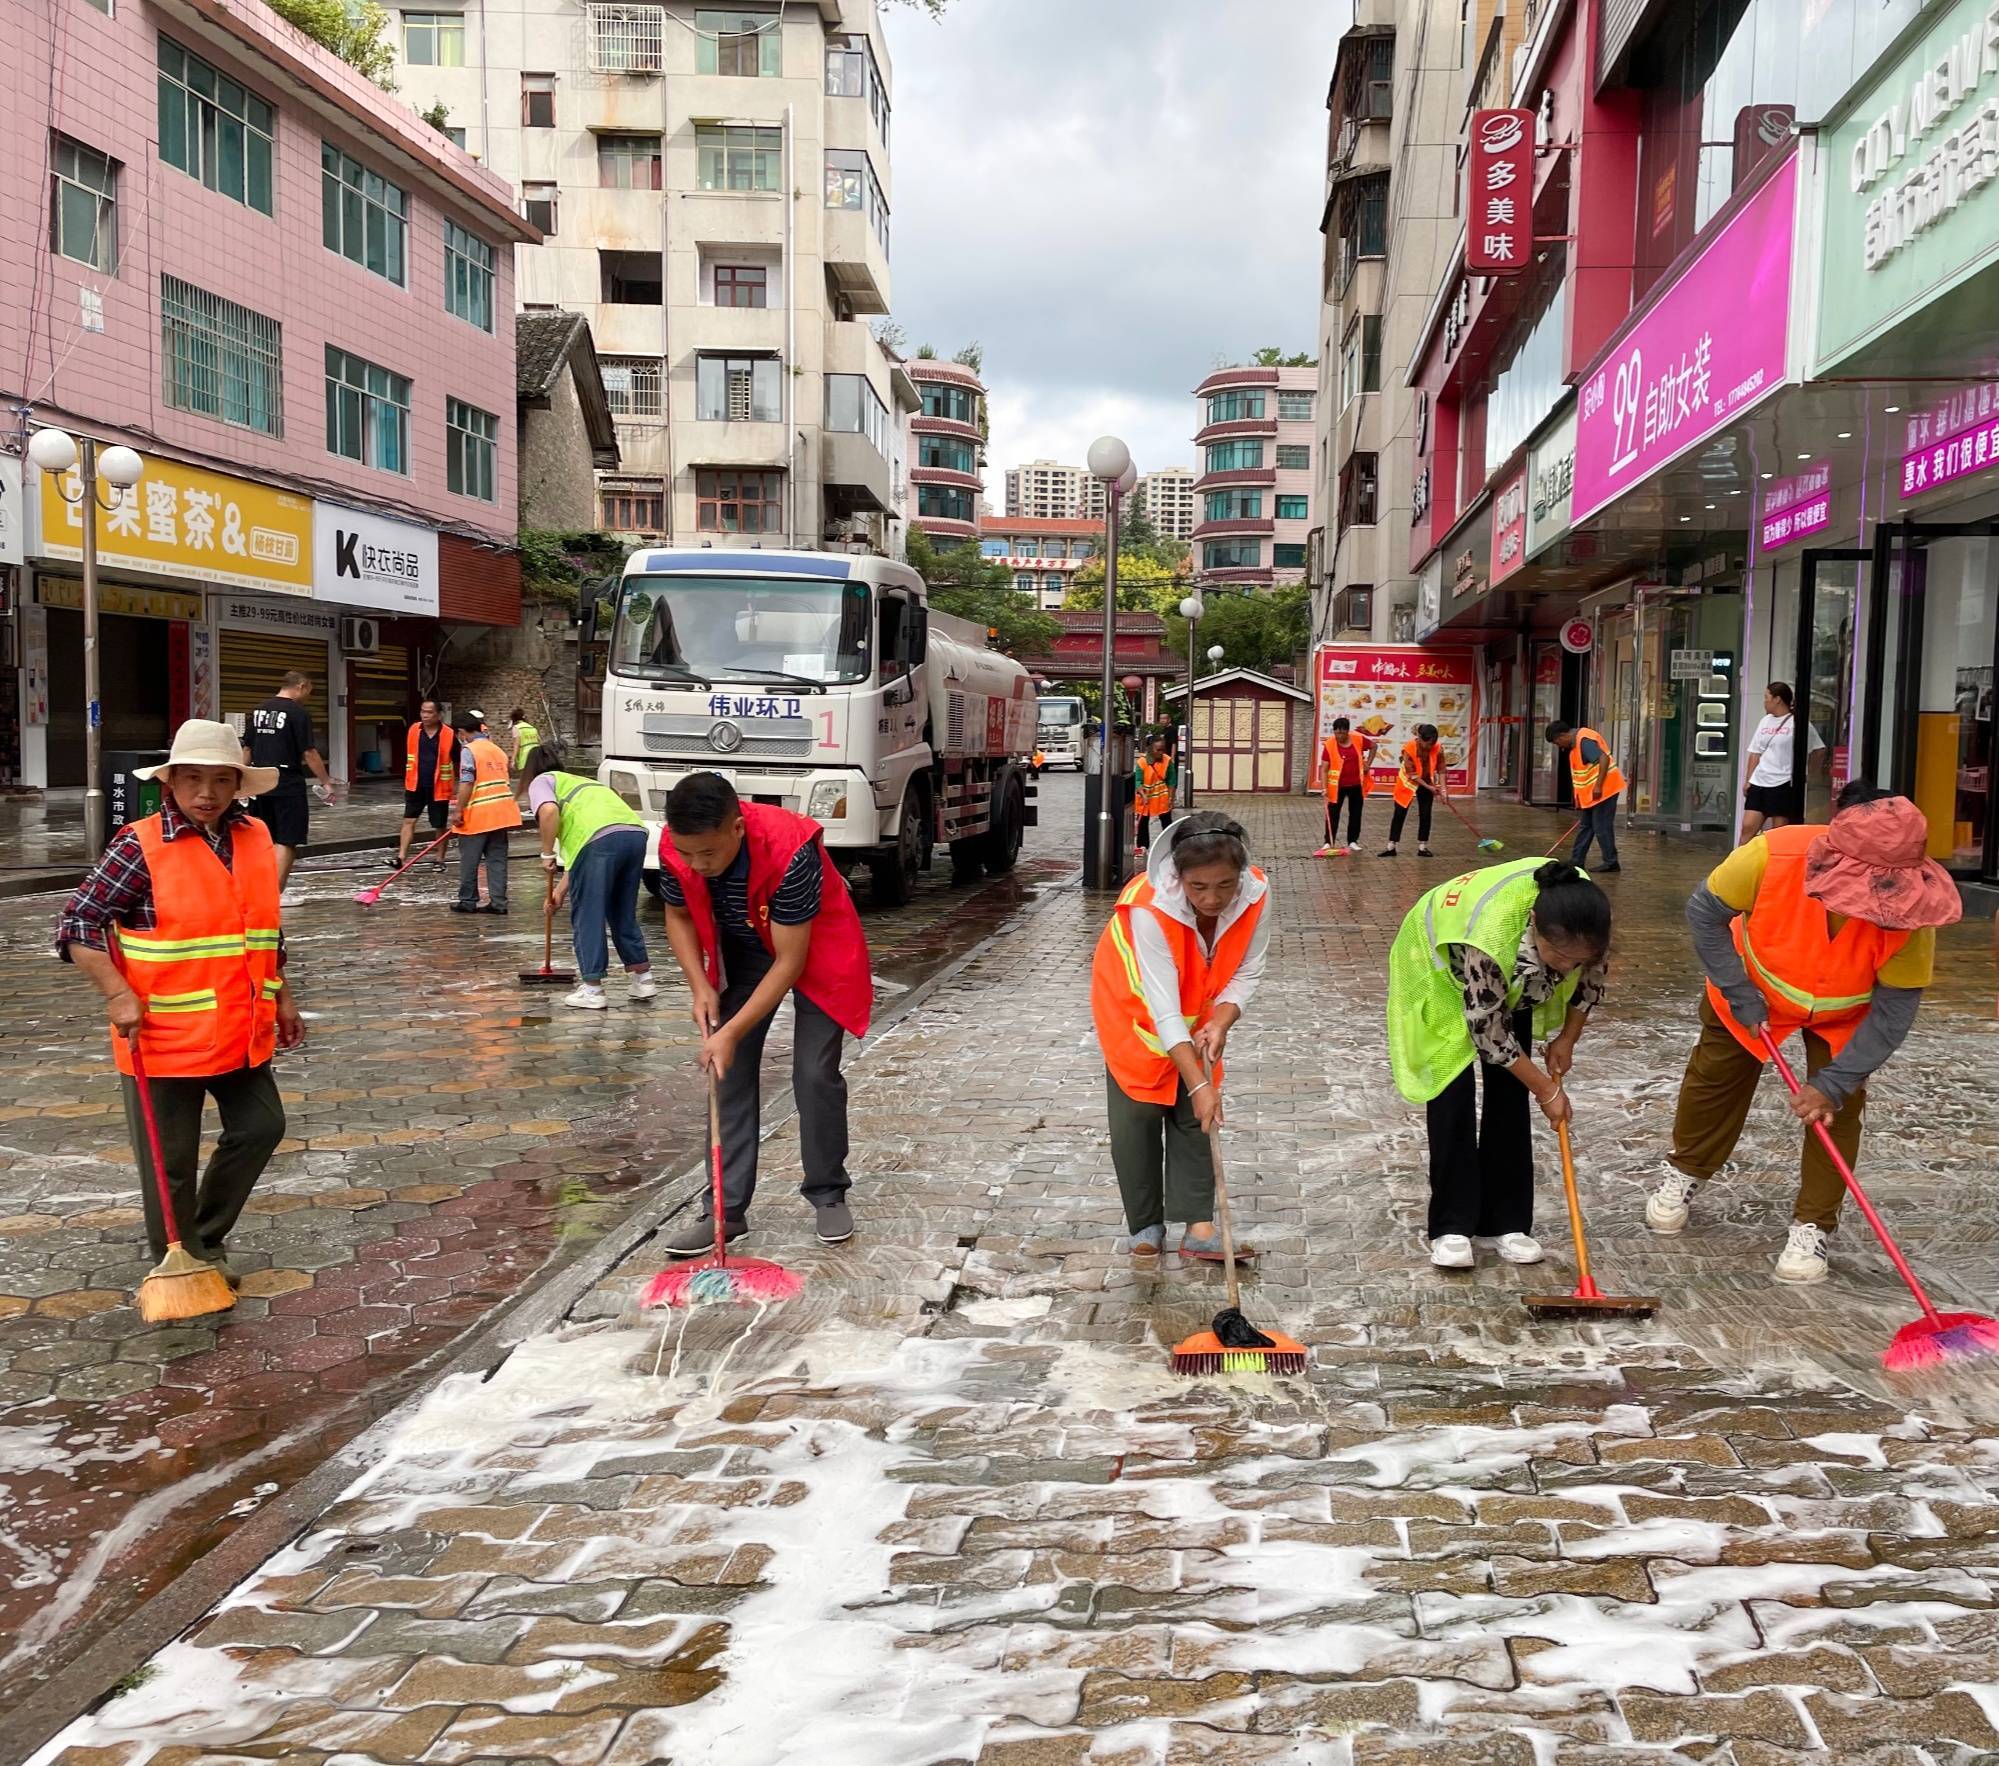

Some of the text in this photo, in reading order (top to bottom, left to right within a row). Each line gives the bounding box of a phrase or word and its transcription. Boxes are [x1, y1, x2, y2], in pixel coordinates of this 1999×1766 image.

[1851, 97, 1911, 193] CITY
[1910, 20, 1984, 141] NEW
[1484, 160, 1517, 261] 多美味
[1613, 330, 1712, 462] 99 自助女装
[1904, 456, 1928, 491] 惠水
[336, 529, 361, 579] K
[362, 544, 419, 578] 快衣尚品
[708, 694, 803, 719] 伟业环卫
[817, 710, 841, 749] 1
[112, 773, 126, 826] 惠水市政
